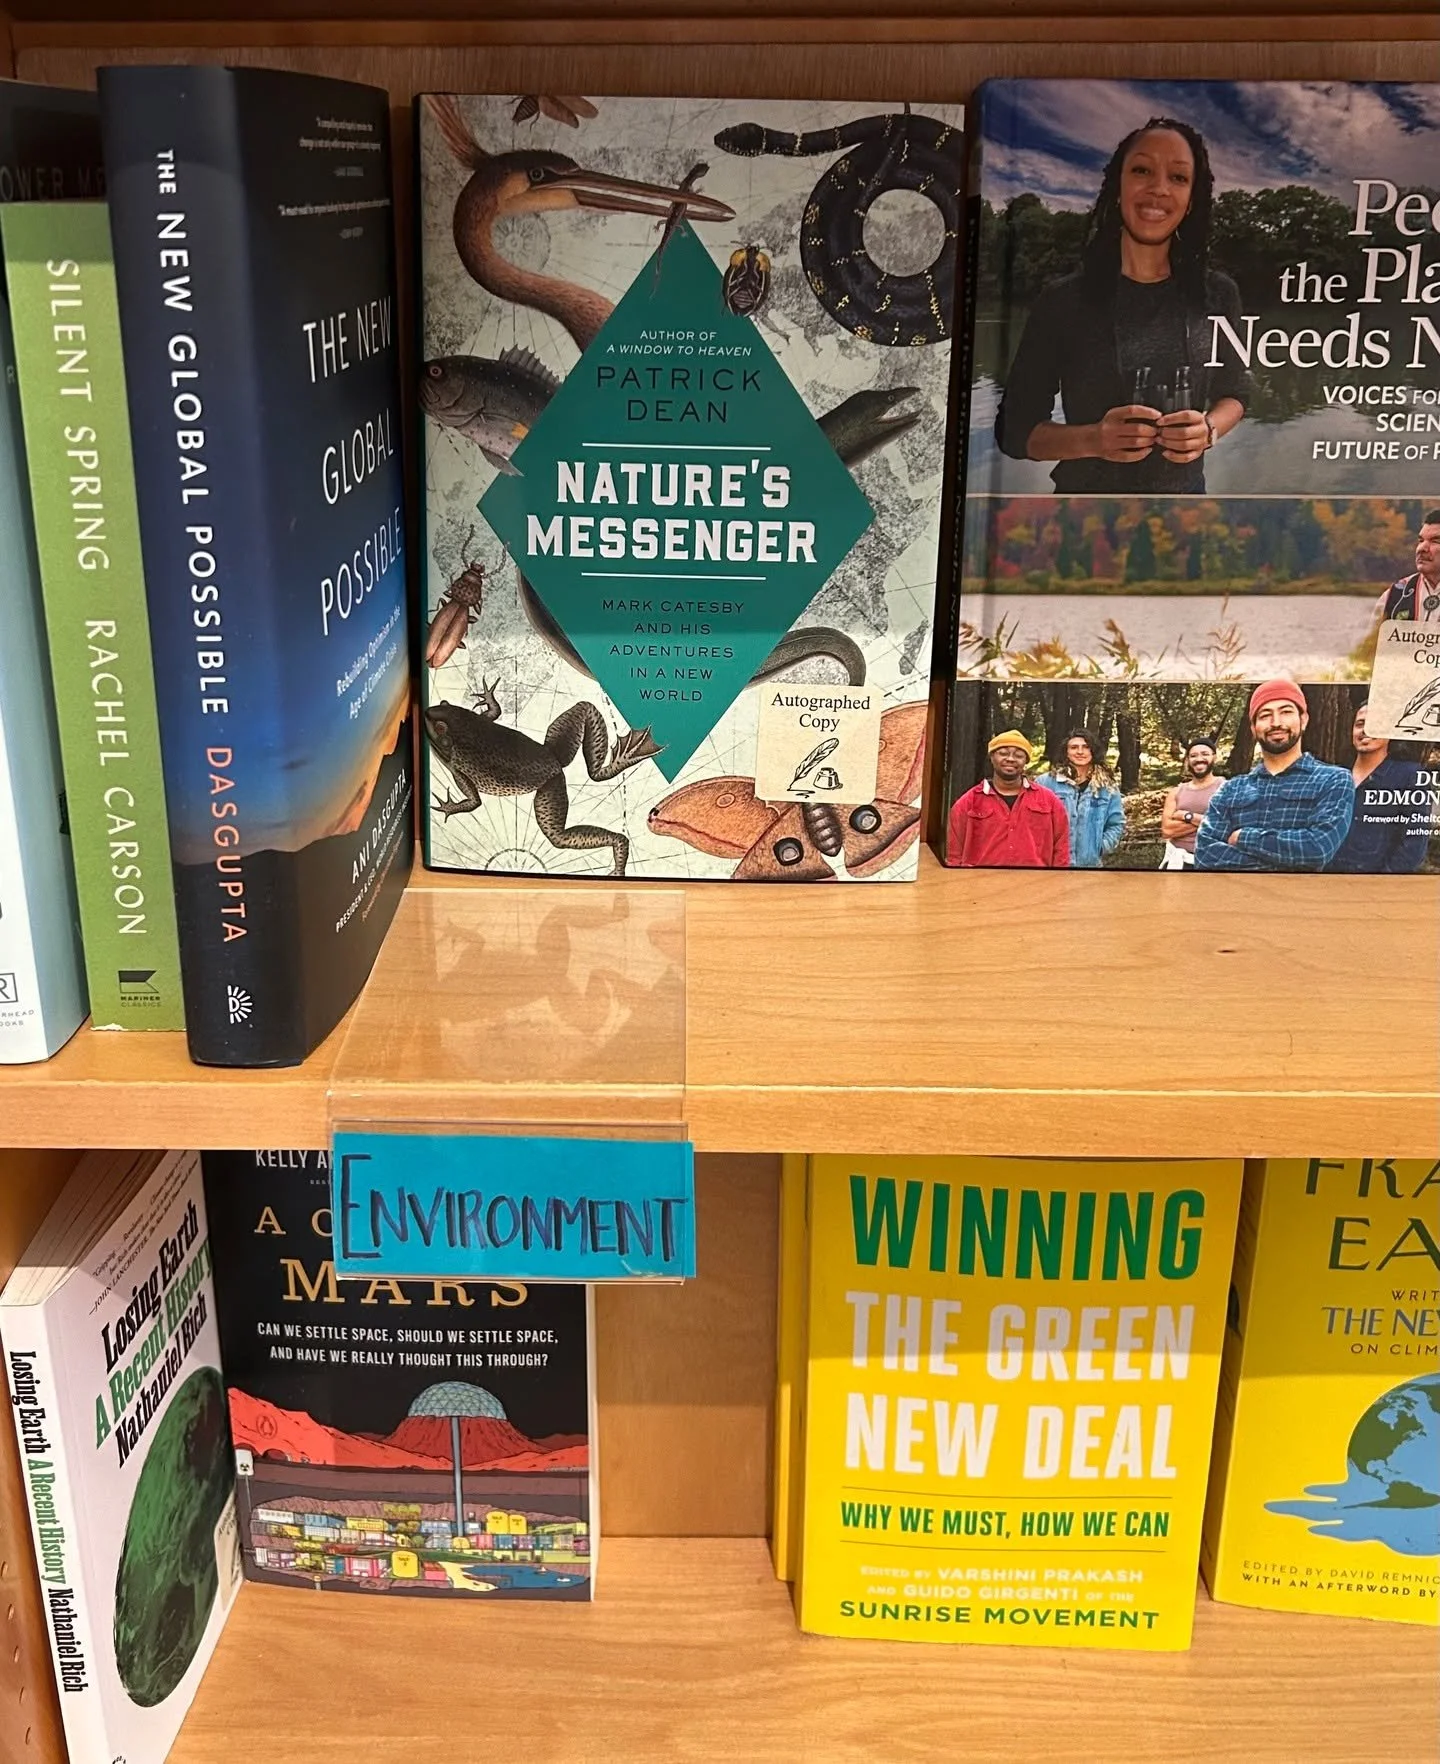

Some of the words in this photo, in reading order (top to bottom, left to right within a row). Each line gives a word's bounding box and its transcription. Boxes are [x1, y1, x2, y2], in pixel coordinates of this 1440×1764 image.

[156, 148, 177, 194] THE
[156, 211, 193, 312] NEW
[1278, 262, 1348, 304] the
[46, 258, 94, 402] SILENT
[302, 312, 351, 384] THE
[356, 295, 392, 362] NEW
[639, 330, 695, 341] AUTHOR
[698, 330, 718, 342] OF
[1203, 311, 1391, 370] Needs
[606, 345, 616, 354] A
[618, 345, 675, 356] WINDOW
[677, 345, 695, 356] TO
[698, 346, 752, 357] HEAVEN
[596, 366, 762, 393] PATRICK
[1322, 385, 1407, 405] VOICES
[1412, 389, 1440, 405] FO
[167, 333, 210, 506] GLOBAL
[626, 400, 728, 424] DEAN
[322, 407, 395, 506] GLOBAL
[1312, 441, 1401, 460] FUTURE
[1404, 445, 1430, 460] OF
[64, 425, 110, 573] SPRING
[555, 458, 792, 510] NATURE'S
[526, 514, 818, 564] MESSENGER
[320, 506, 403, 637] POSSIBLE
[185, 525, 230, 715] POSSIBLE
[601, 599, 653, 613] MARK
[659, 600, 746, 614] CATESBY
[633, 623, 675, 635] AND
[679, 623, 712, 636] HIS
[608, 645, 735, 659] ADVENTURES
[84, 619, 129, 767] RACHEL
[629, 667, 650, 680] IN
[654, 667, 668, 680] A
[673, 667, 714, 680] NEW
[638, 689, 703, 702] WORLD
[771, 692, 871, 713] Autographed
[798, 712, 841, 733] Copy
[351, 840, 371, 885] ANI
[371, 767, 407, 850] DASGUPTA
[1363, 814, 1400, 824] Foreword
[1400, 815, 1410, 825] by
[1406, 828, 1433, 836] author
[103, 786, 148, 935] CARSON
[205, 746, 248, 943] DASGUPTA
[255, 1150, 308, 1168] KELLY
[253, 1206, 287, 1235] A
[339, 1152, 691, 1262] ENVIRONMENT
[848, 1174, 1206, 1281] WINNING
[101, 1265, 161, 1375] Losing
[158, 1199, 199, 1291] Earth
[257, 1321, 281, 1337] CAN
[284, 1324, 303, 1338] WE
[306, 1325, 349, 1340] SETTLE
[351, 1327, 394, 1343] SPACE,
[397, 1329, 444, 1344] SHOULD
[447, 1330, 466, 1344] WE
[469, 1330, 513, 1344] SETTLE
[516, 1330, 559, 1345] SPACE,
[845, 1290, 963, 1376] THE
[986, 1302, 1196, 1382] GREEN
[1321, 1306, 1385, 1336] THE
[1392, 1308, 1440, 1337] NE
[96, 1393, 112, 1450] A
[108, 1311, 167, 1425] Recent
[164, 1236, 213, 1340] History
[269, 1346, 294, 1360] AND
[296, 1347, 327, 1362] HAVE
[329, 1349, 348, 1363] WE
[351, 1350, 395, 1365] REALLY
[398, 1352, 452, 1367] THOUGHT
[456, 1353, 483, 1367] THIS
[486, 1353, 549, 1368] THROUGH?
[1350, 1343, 1379, 1355] ON
[10, 1351, 41, 1406] Losing
[114, 1337, 184, 1469] Nathaniel
[181, 1291, 208, 1359] Rich
[19, 1407, 52, 1455] Earth
[844, 1392, 999, 1479] NEW
[1022, 1404, 1178, 1481] DEAL
[27, 1458, 54, 1471] A
[30, 1472, 60, 1526] Recent
[840, 1500, 892, 1531] WHY
[900, 1505, 934, 1533] WE
[941, 1508, 1011, 1540] MUST,
[1021, 1511, 1074, 1538] HOW
[1082, 1511, 1117, 1538] WE
[1124, 1511, 1170, 1538] CAN
[38, 1526, 67, 1585] History
[860, 1565, 910, 1579] EDITED
[914, 1570, 933, 1580] BY
[937, 1567, 1037, 1583] VARSHINI
[1043, 1568, 1144, 1584] PRAKASH
[1243, 1560, 1299, 1575] EDITED
[1305, 1567, 1324, 1577] BY
[1330, 1569, 1375, 1580] DAVID
[867, 1584, 897, 1596] AND
[903, 1584, 972, 1599] GUIDO
[979, 1586, 1079, 1602] GIRGENTI
[1085, 1591, 1104, 1602] OF
[1242, 1573, 1282, 1586] WITH
[1289, 1579, 1309, 1588] AN
[1315, 1581, 1411, 1597] AFTERWORD
[1418, 1589, 1437, 1599] BY
[47, 1587, 85, 1660] Nathaniel
[839, 1600, 972, 1624] SUNRISE
[984, 1606, 1161, 1630] MOVEMENT
[59, 1660, 89, 1693] Rich
